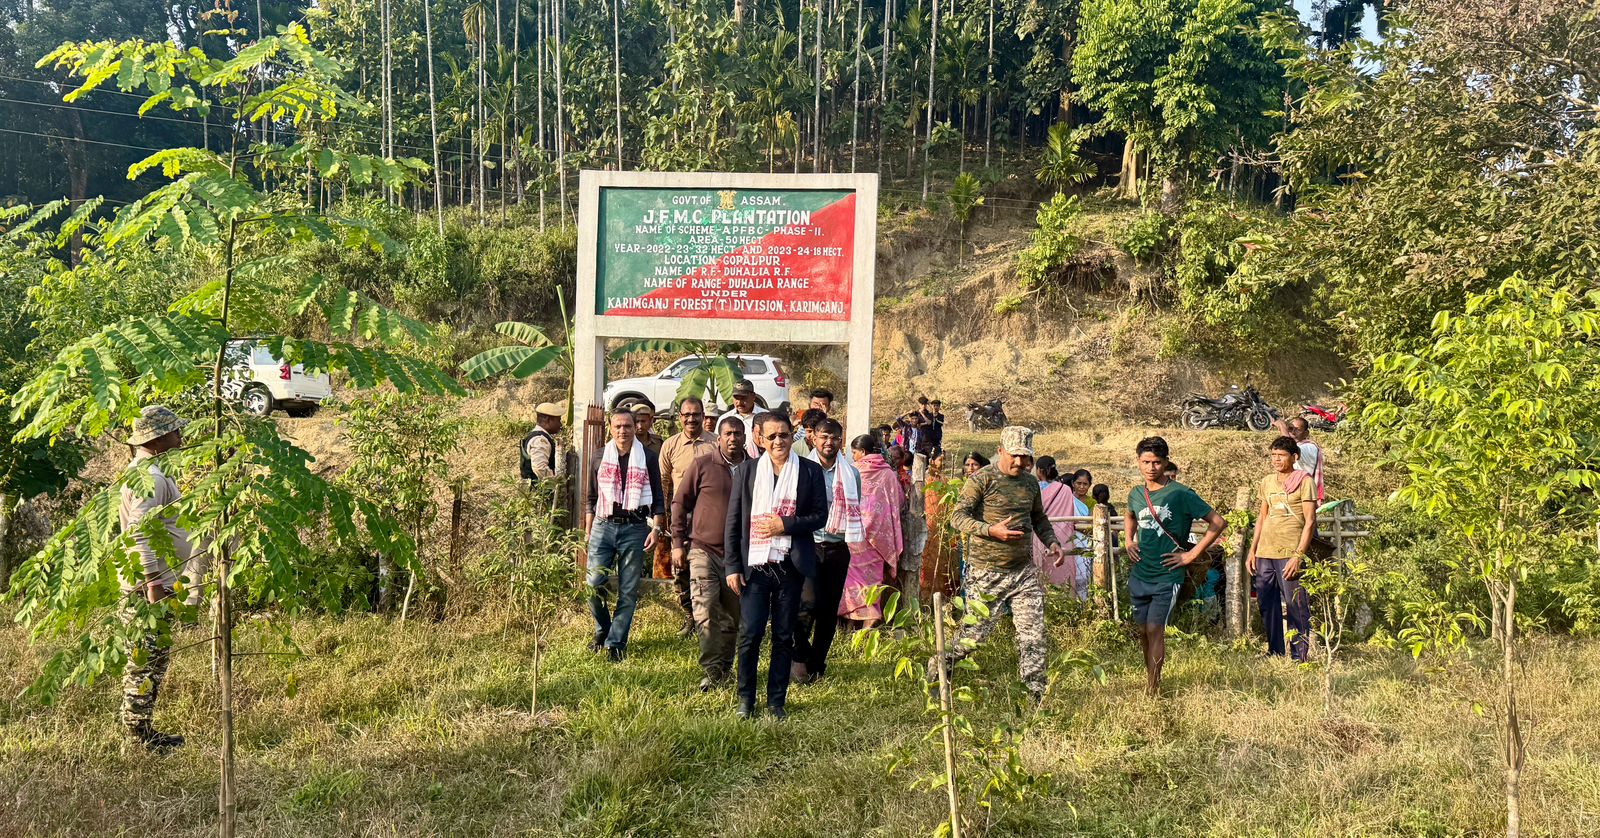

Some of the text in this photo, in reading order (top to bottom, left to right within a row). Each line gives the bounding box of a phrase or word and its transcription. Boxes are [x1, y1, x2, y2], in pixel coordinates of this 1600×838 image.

[700, 195, 712, 205] OF
[741, 196, 786, 206] ASSAM.
[711, 209, 814, 226] PLANTATION.
[635, 225, 662, 234] NAME
[666, 225, 676, 234] OF
[742, 245, 763, 255] AND
[655, 266, 682, 276] NAME
[685, 267, 698, 276] OF
[643, 278, 673, 288] NAME
[675, 278, 688, 288] OF
[701, 290, 748, 298] UNDER
[607, 297, 669, 309] KARIMGANJ
